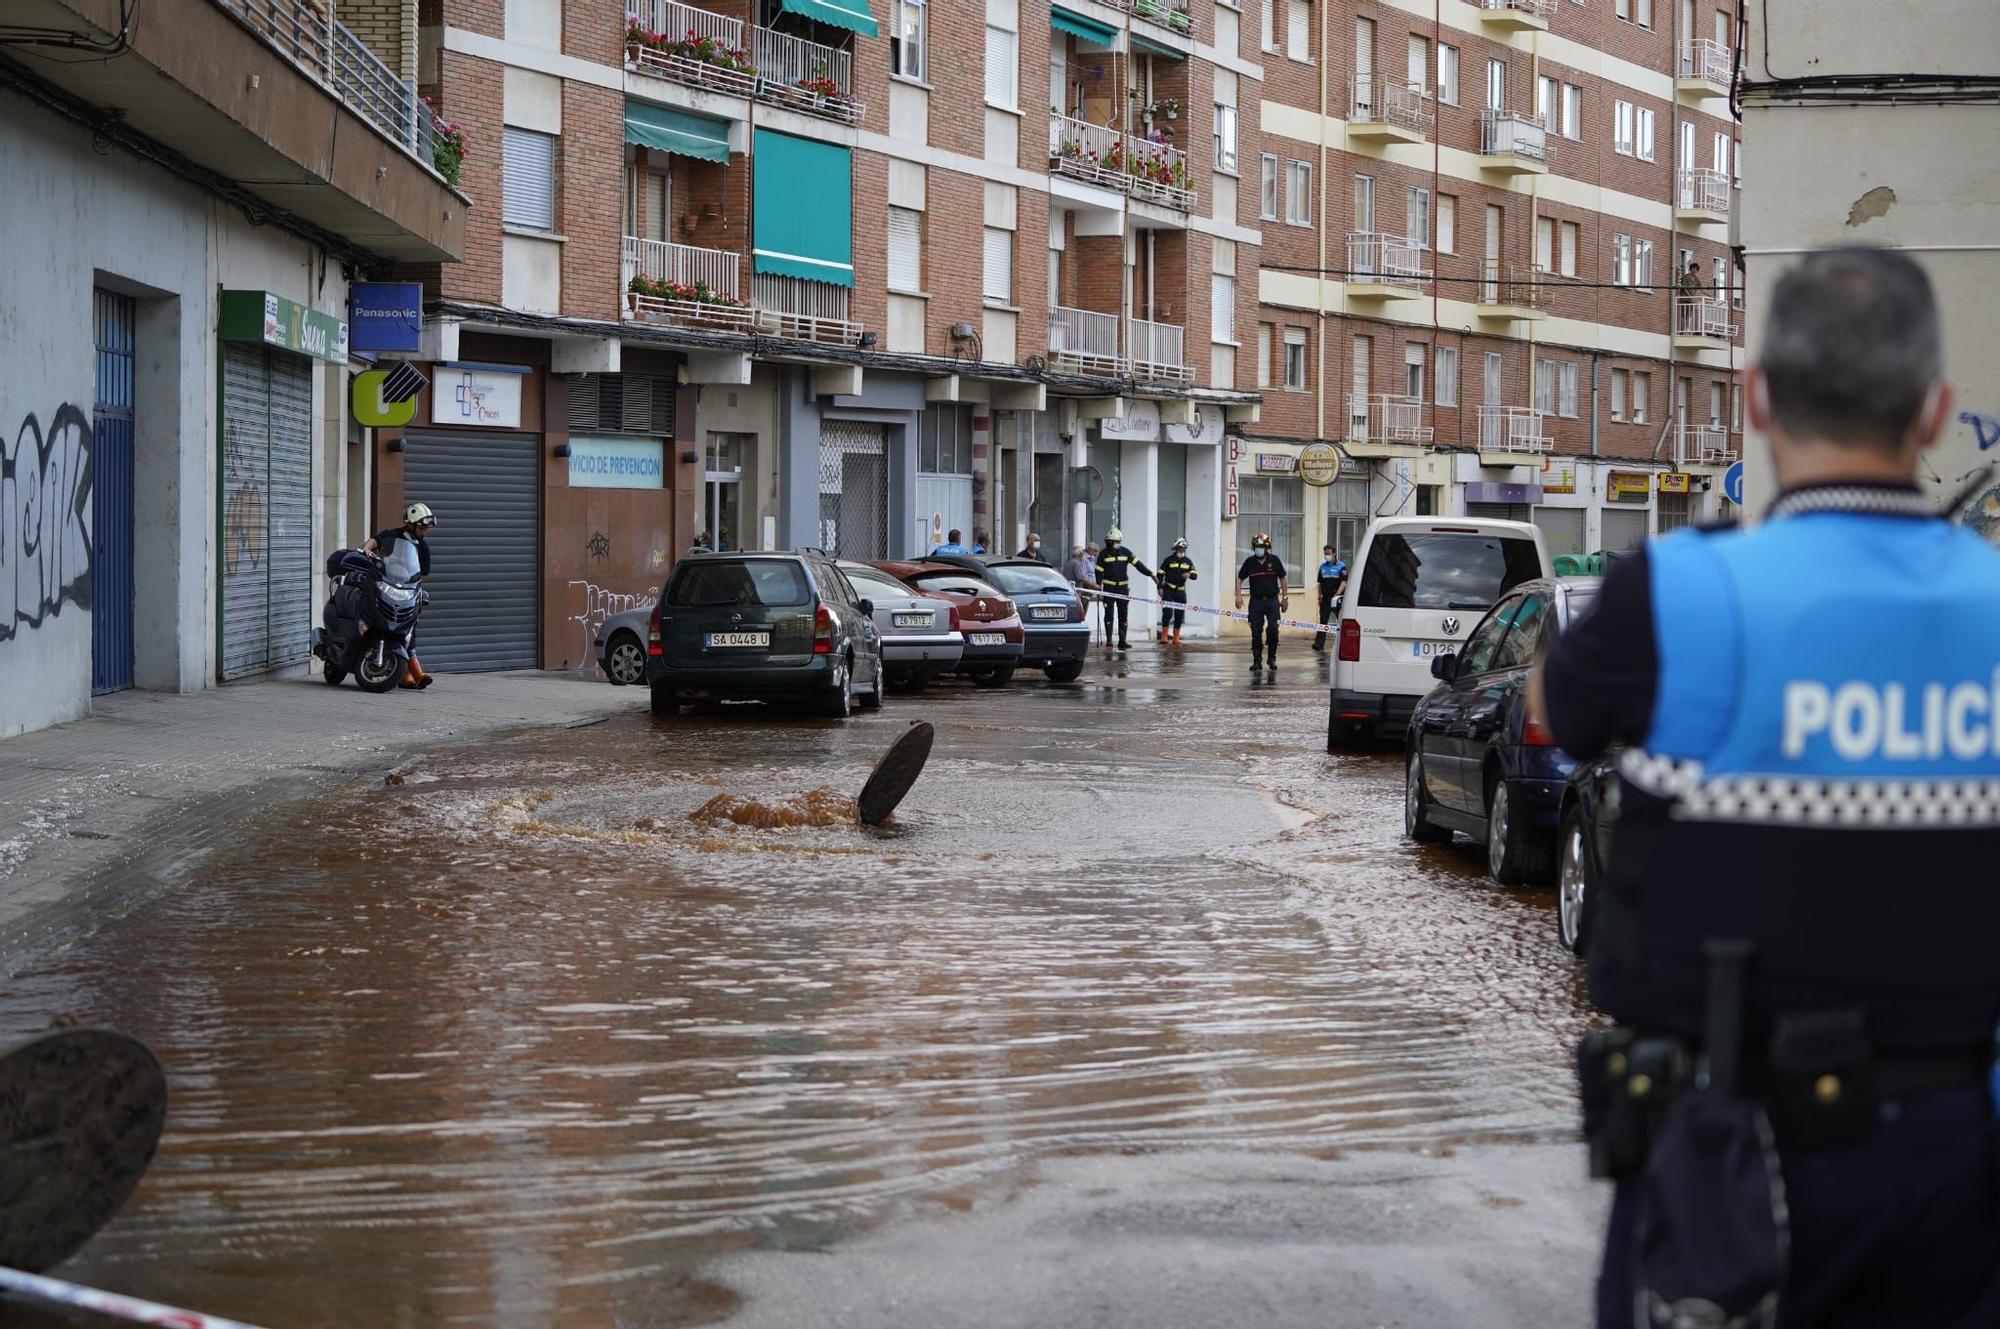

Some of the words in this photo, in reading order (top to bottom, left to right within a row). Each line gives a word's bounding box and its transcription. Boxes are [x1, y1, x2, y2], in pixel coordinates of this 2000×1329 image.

[355, 307, 417, 318] Panasonic
[473, 396, 480, 410] 3
[597, 455, 608, 474] DE
[609, 454, 660, 476] PREVENCIÓN
[1229, 439, 1239, 515] BAR
[713, 634, 727, 645] SA
[730, 634, 757, 645] 0448
[761, 634, 768, 645] U
